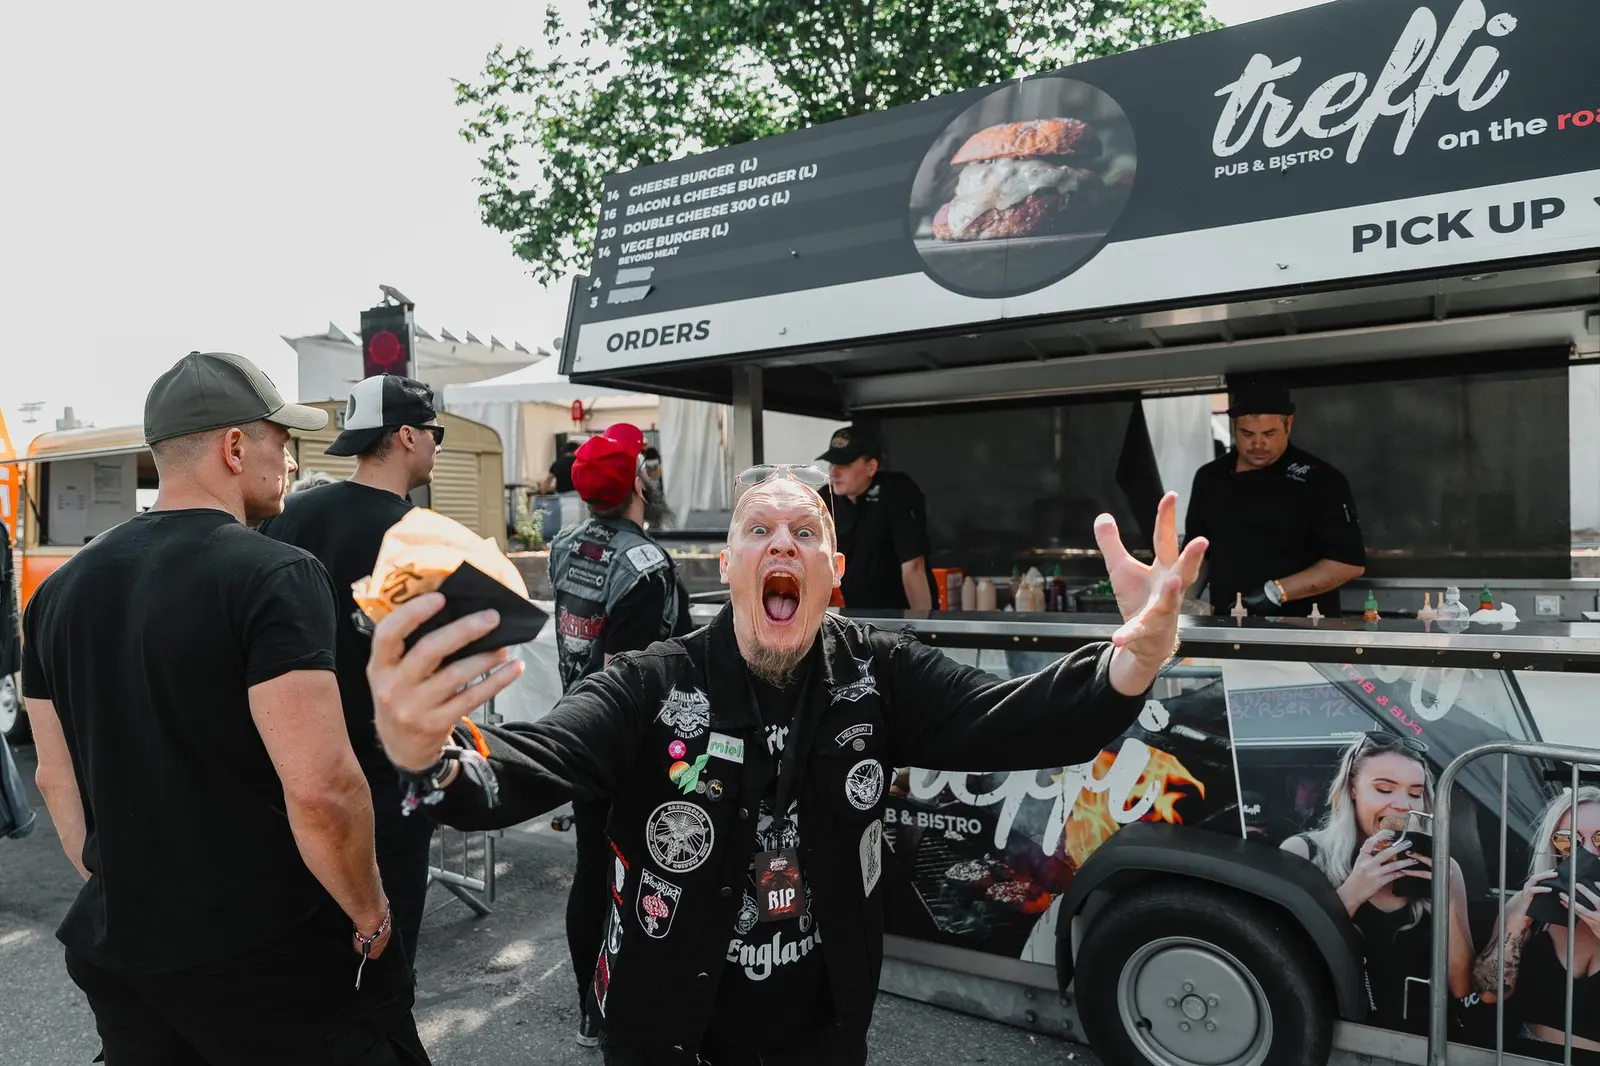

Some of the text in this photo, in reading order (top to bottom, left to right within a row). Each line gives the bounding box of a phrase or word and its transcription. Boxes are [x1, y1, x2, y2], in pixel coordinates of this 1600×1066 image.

[1212, 0, 1518, 164] treffi
[1437, 108, 1600, 150] on the ro
[606, 157, 759, 202] 14 CHEESE BURGER (L)
[1214, 147, 1334, 179] PUB & BISTRO
[603, 163, 818, 221] 16 BACON & CHEESE BURGER (L)
[601, 190, 790, 240] 20 DOUBLE CHEESE 300 G (L)
[1352, 197, 1565, 254] PICK UP
[598, 222, 730, 259] 14 VEGE BURGER (L)
[618, 246, 680, 266] BEYOND MEAT
[593, 277, 602, 289] 4
[590, 296, 598, 308] 3
[606, 319, 711, 353] ORDERS
[841, 726, 868, 741] HELSINKI
[916, 811, 983, 835] BISTRO
[768, 888, 796, 911] RIP
